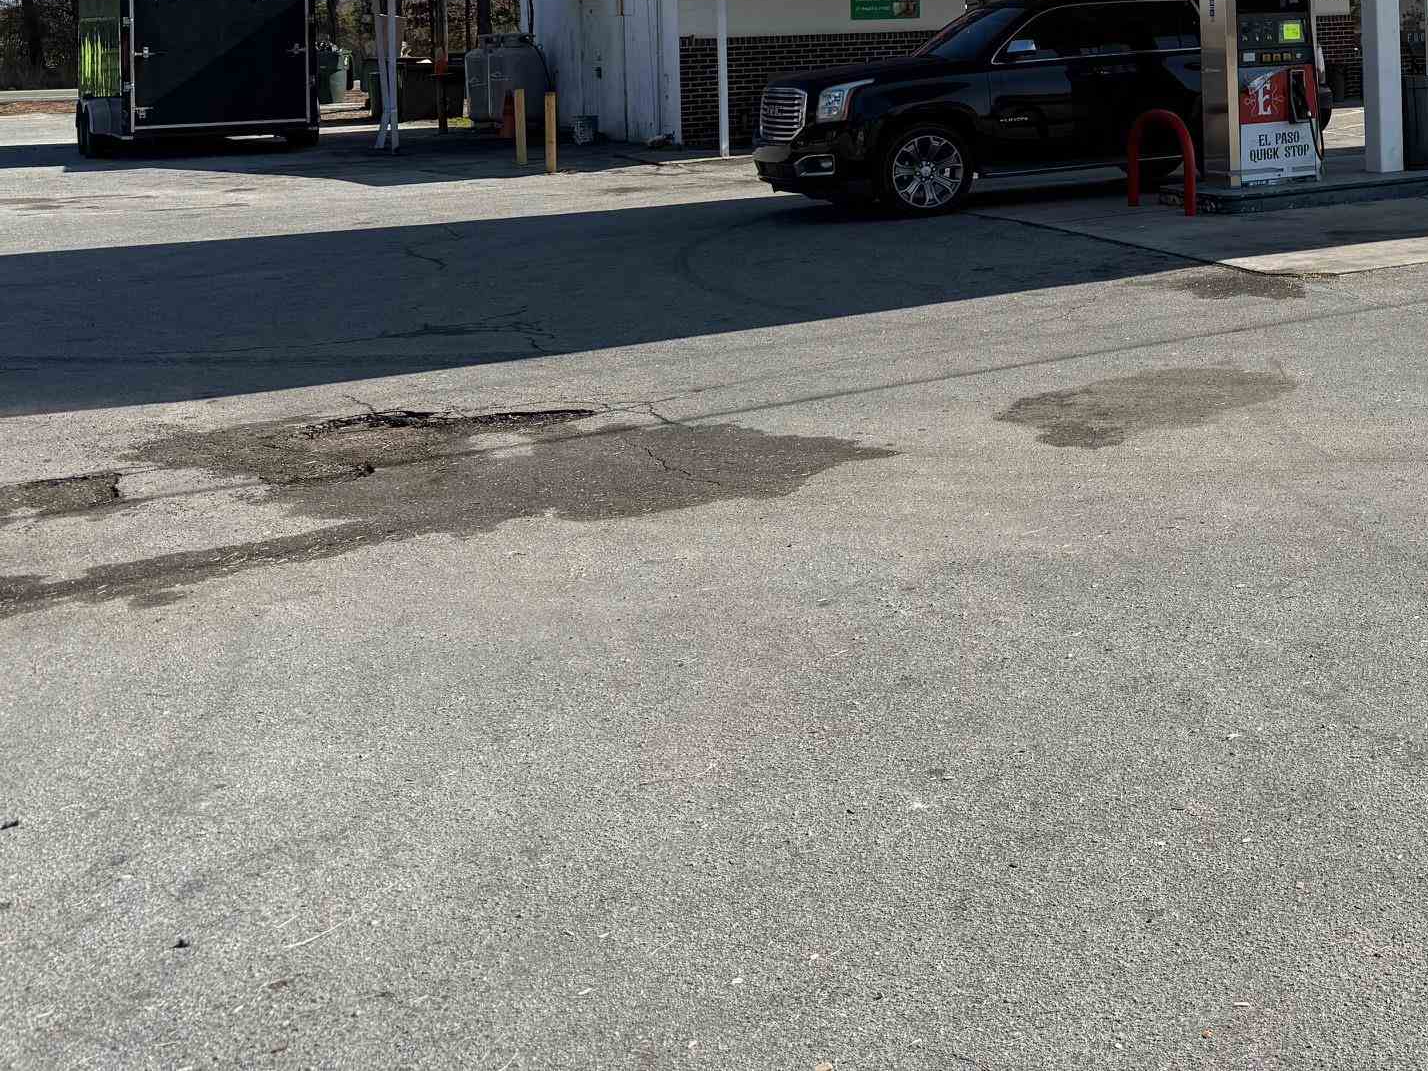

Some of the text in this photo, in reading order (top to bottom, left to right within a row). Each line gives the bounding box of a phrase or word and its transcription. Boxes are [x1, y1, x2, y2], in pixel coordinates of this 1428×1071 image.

[1258, 131, 1299, 146] EL PASO
[1250, 144, 1309, 162] QUICK STOP
